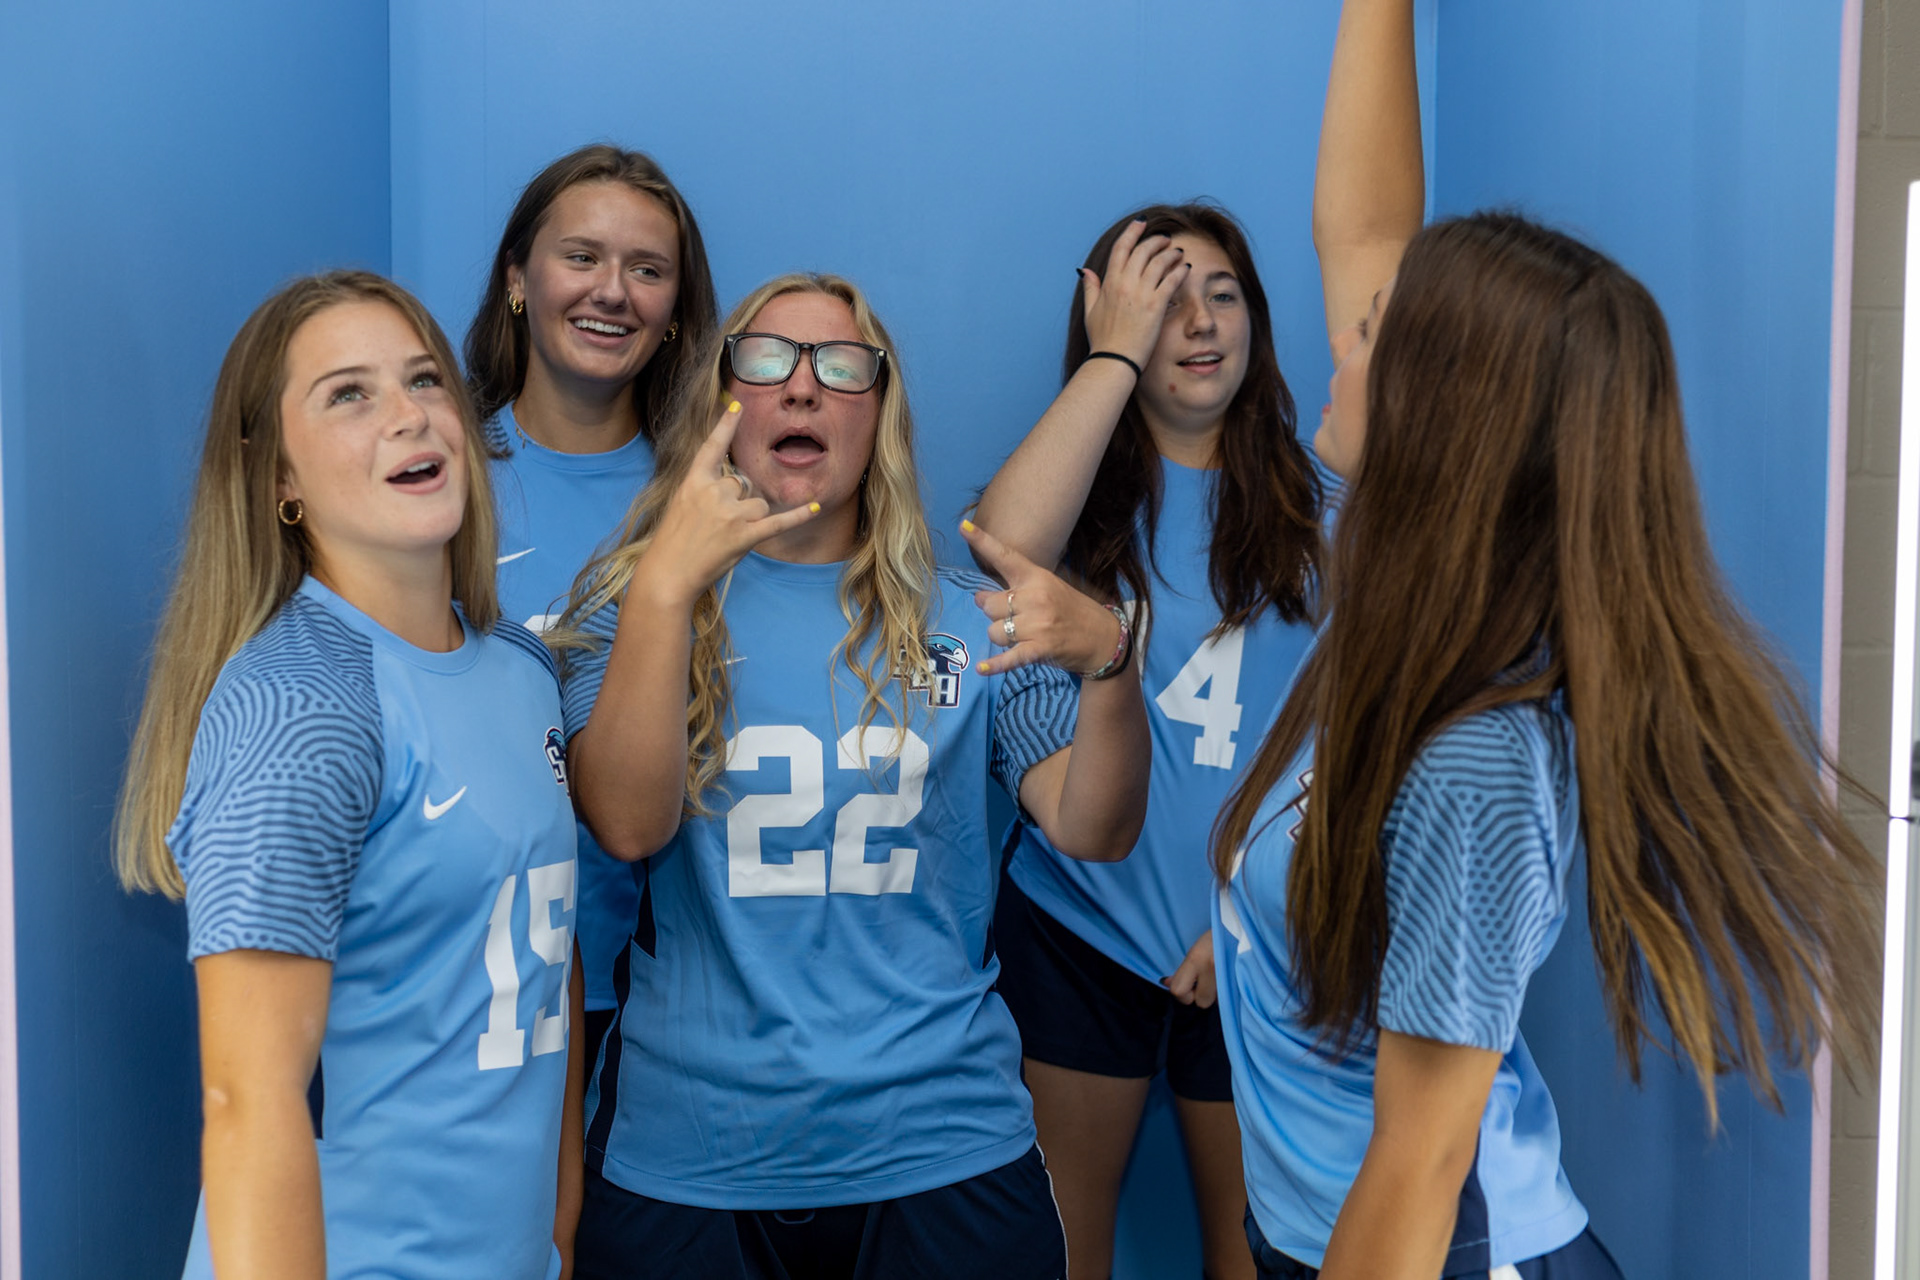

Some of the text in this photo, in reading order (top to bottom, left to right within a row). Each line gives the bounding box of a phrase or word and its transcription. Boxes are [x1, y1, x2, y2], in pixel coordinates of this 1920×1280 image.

[1123, 599, 1246, 770] 4
[725, 725, 929, 897] 22
[477, 858, 575, 1071] 15
